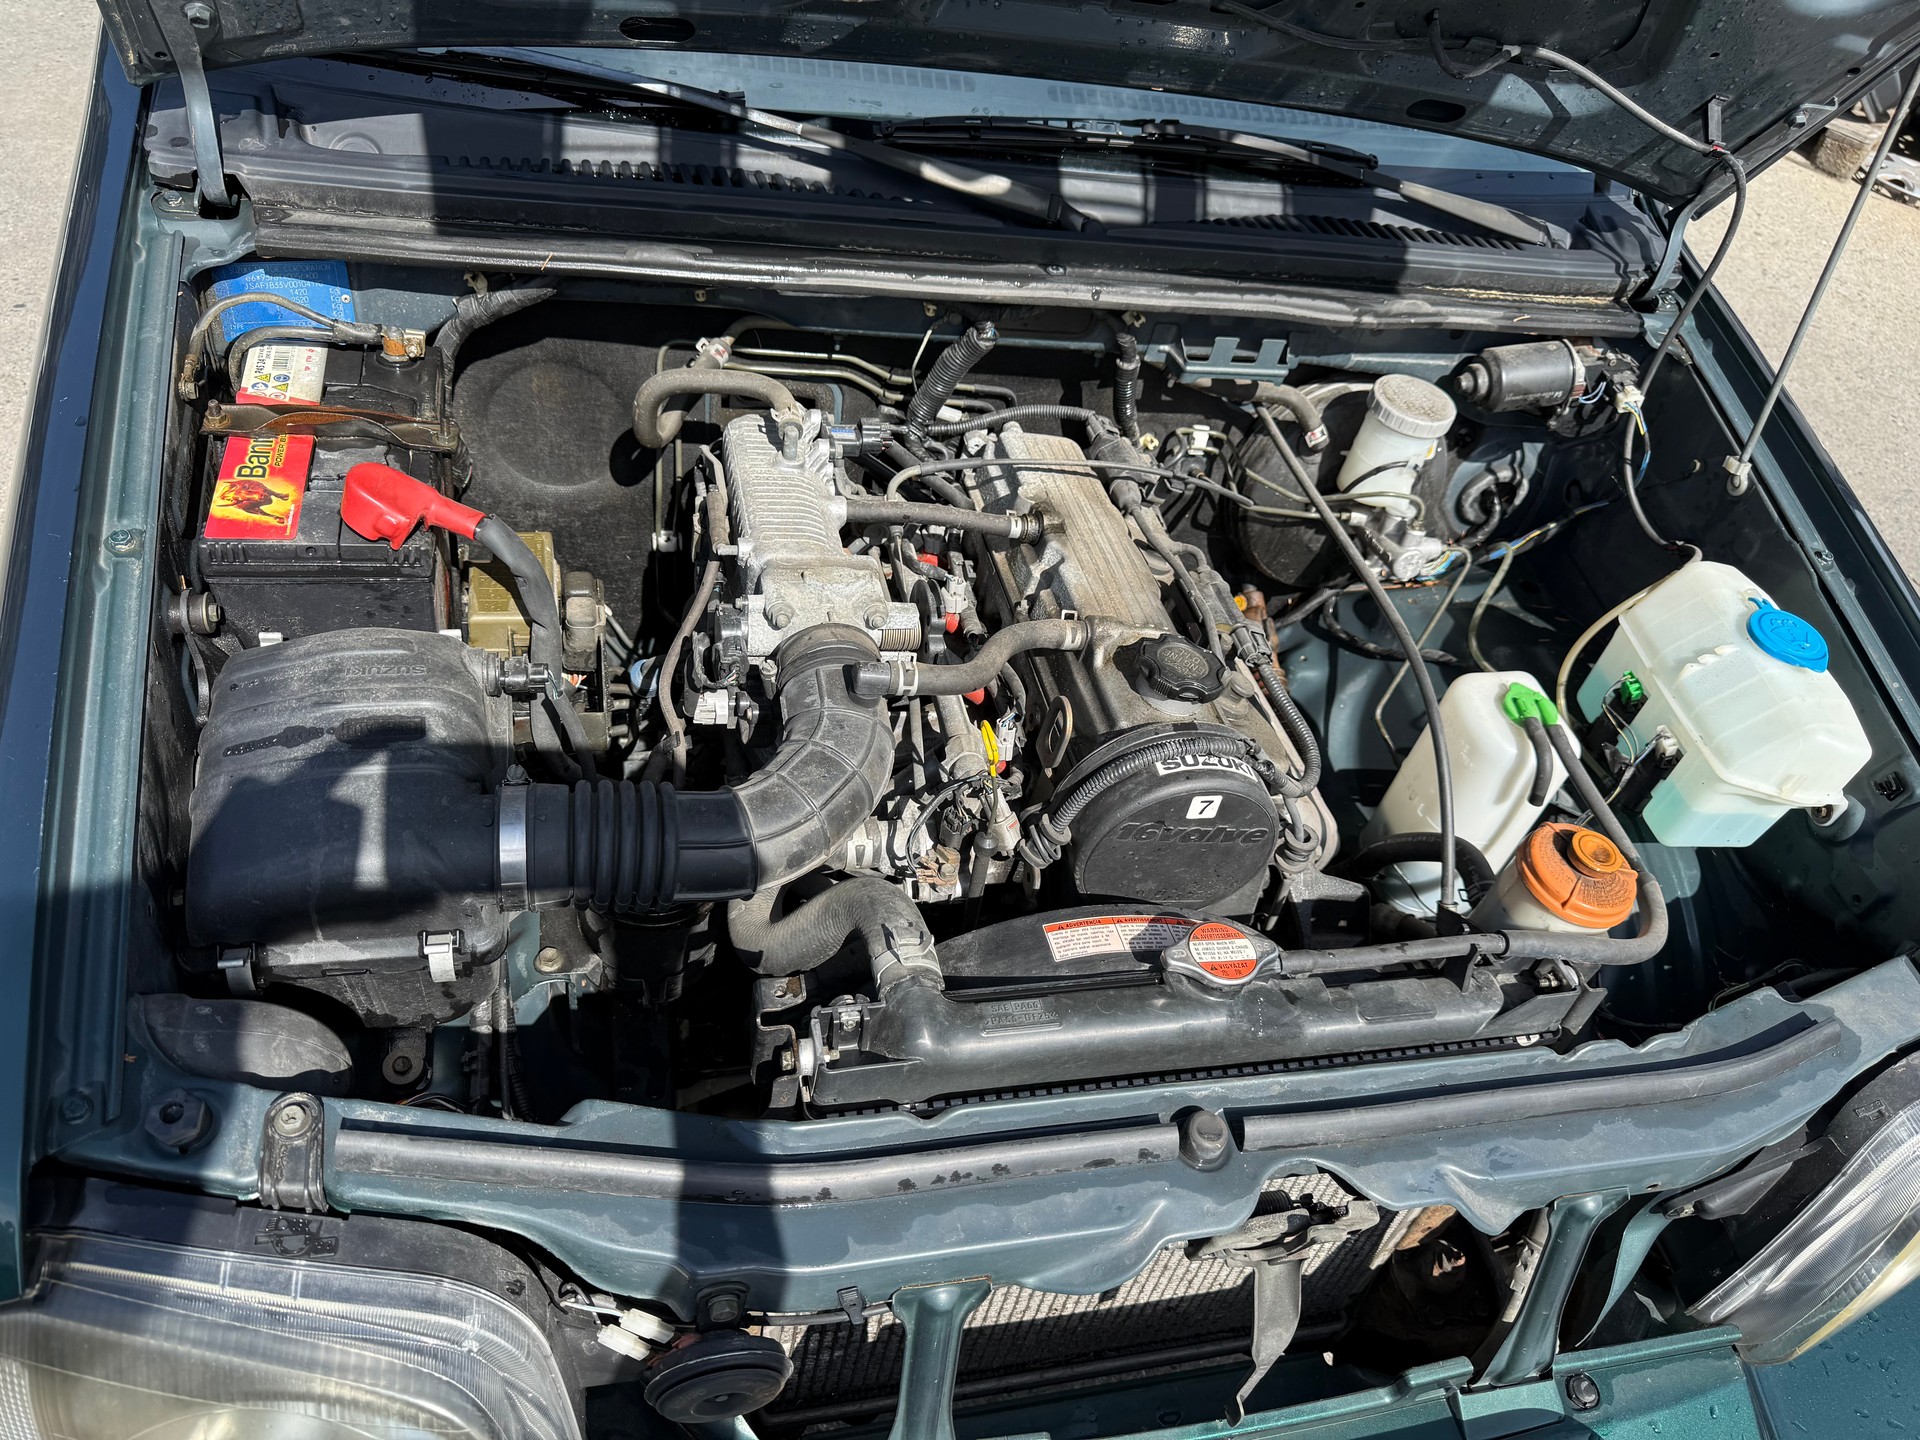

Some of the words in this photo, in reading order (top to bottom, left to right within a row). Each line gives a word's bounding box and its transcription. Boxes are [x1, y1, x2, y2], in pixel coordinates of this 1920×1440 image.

[283, 263, 331, 272] CORPORATION
[290, 288, 308, 296] 1420
[274, 444, 285, 467] POWER
[1162, 649, 1205, 675] ENGINE
[1179, 647, 1201, 664] OIL
[345, 664, 427, 677] SUZUKI
[1198, 800, 1214, 815] 7
[991, 1004, 1010, 1013] SAE
[1014, 1001, 1039, 1010] PA66
